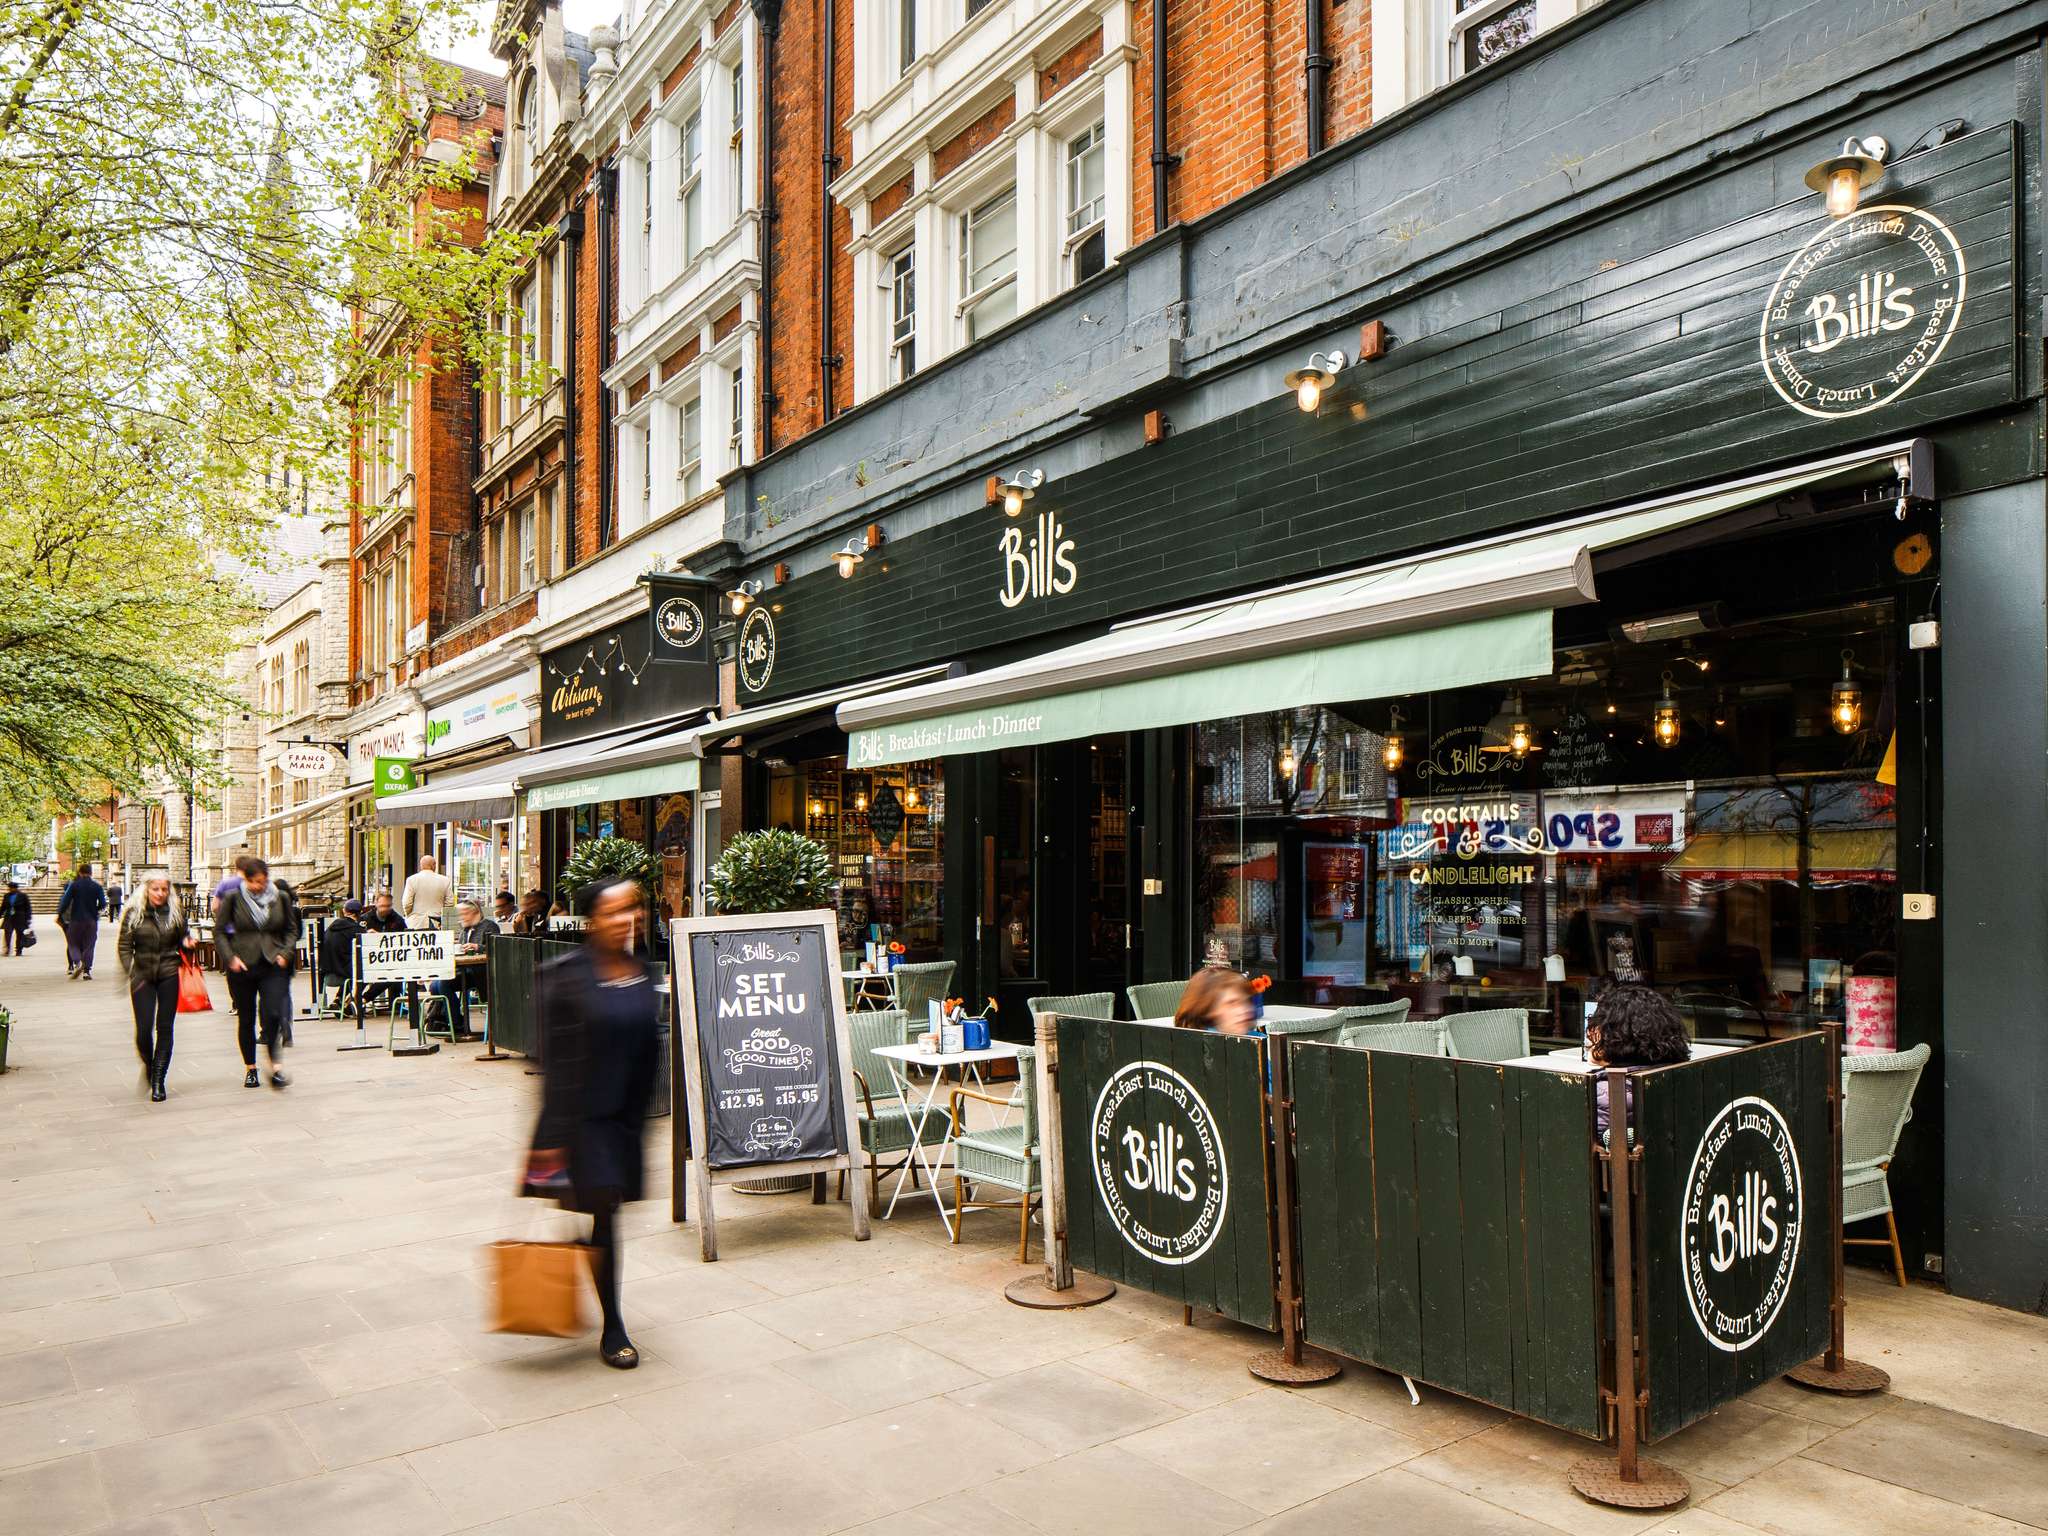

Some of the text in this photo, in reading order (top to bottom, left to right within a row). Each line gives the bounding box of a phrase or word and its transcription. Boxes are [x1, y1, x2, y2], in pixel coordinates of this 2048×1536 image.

[1772, 217, 1948, 321] Breakfast Lunch Dinner
[1805, 271, 1915, 354] Bill's
[1774, 296, 1953, 406] Breakfast Lunch Dinner
[999, 511, 1077, 607] Bill's
[666, 611, 693, 632] Bill's
[746, 634, 767, 664] Bill's
[857, 715, 1042, 763] Bill's Breakfast Lunch Dinner
[288, 754, 325, 763] FRANCO
[289, 762, 325, 770] MANCA
[1451, 744, 1487, 775] Bill's
[384, 783, 408, 792] OXFAM
[1422, 803, 1520, 824] COCKTAILS
[1457, 831, 1482, 860] &
[1409, 864, 1535, 884] CANDLELIGHT
[1433, 896, 1509, 905] CLASSIC DISHES
[1479, 916, 1527, 925] DESSERTS
[742, 942, 775, 962] Bill's
[1447, 937, 1494, 946] AND MORE
[735, 972, 786, 995] SET
[718, 993, 806, 1019] MENU
[751, 1027, 782, 1038] Great
[741, 1037, 790, 1051] FOOD
[734, 1053, 799, 1066] GOOD TIMES
[720, 1094, 764, 1110] £12.95
[776, 1090, 818, 1105] £15.95
[757, 1123, 768, 1133] 12
[1098, 1071, 1217, 1170] Breakfast Lunch Dinner
[1122, 1122, 1197, 1202] Bill's
[1687, 1110, 1794, 1225] Breakfast Lunch Dinner
[1101, 1160, 1221, 1255] Breakfast Lunch Dinner
[1708, 1170, 1778, 1272] Bill's
[1690, 1221, 1797, 1336] Breakfast Lunch Dinner
